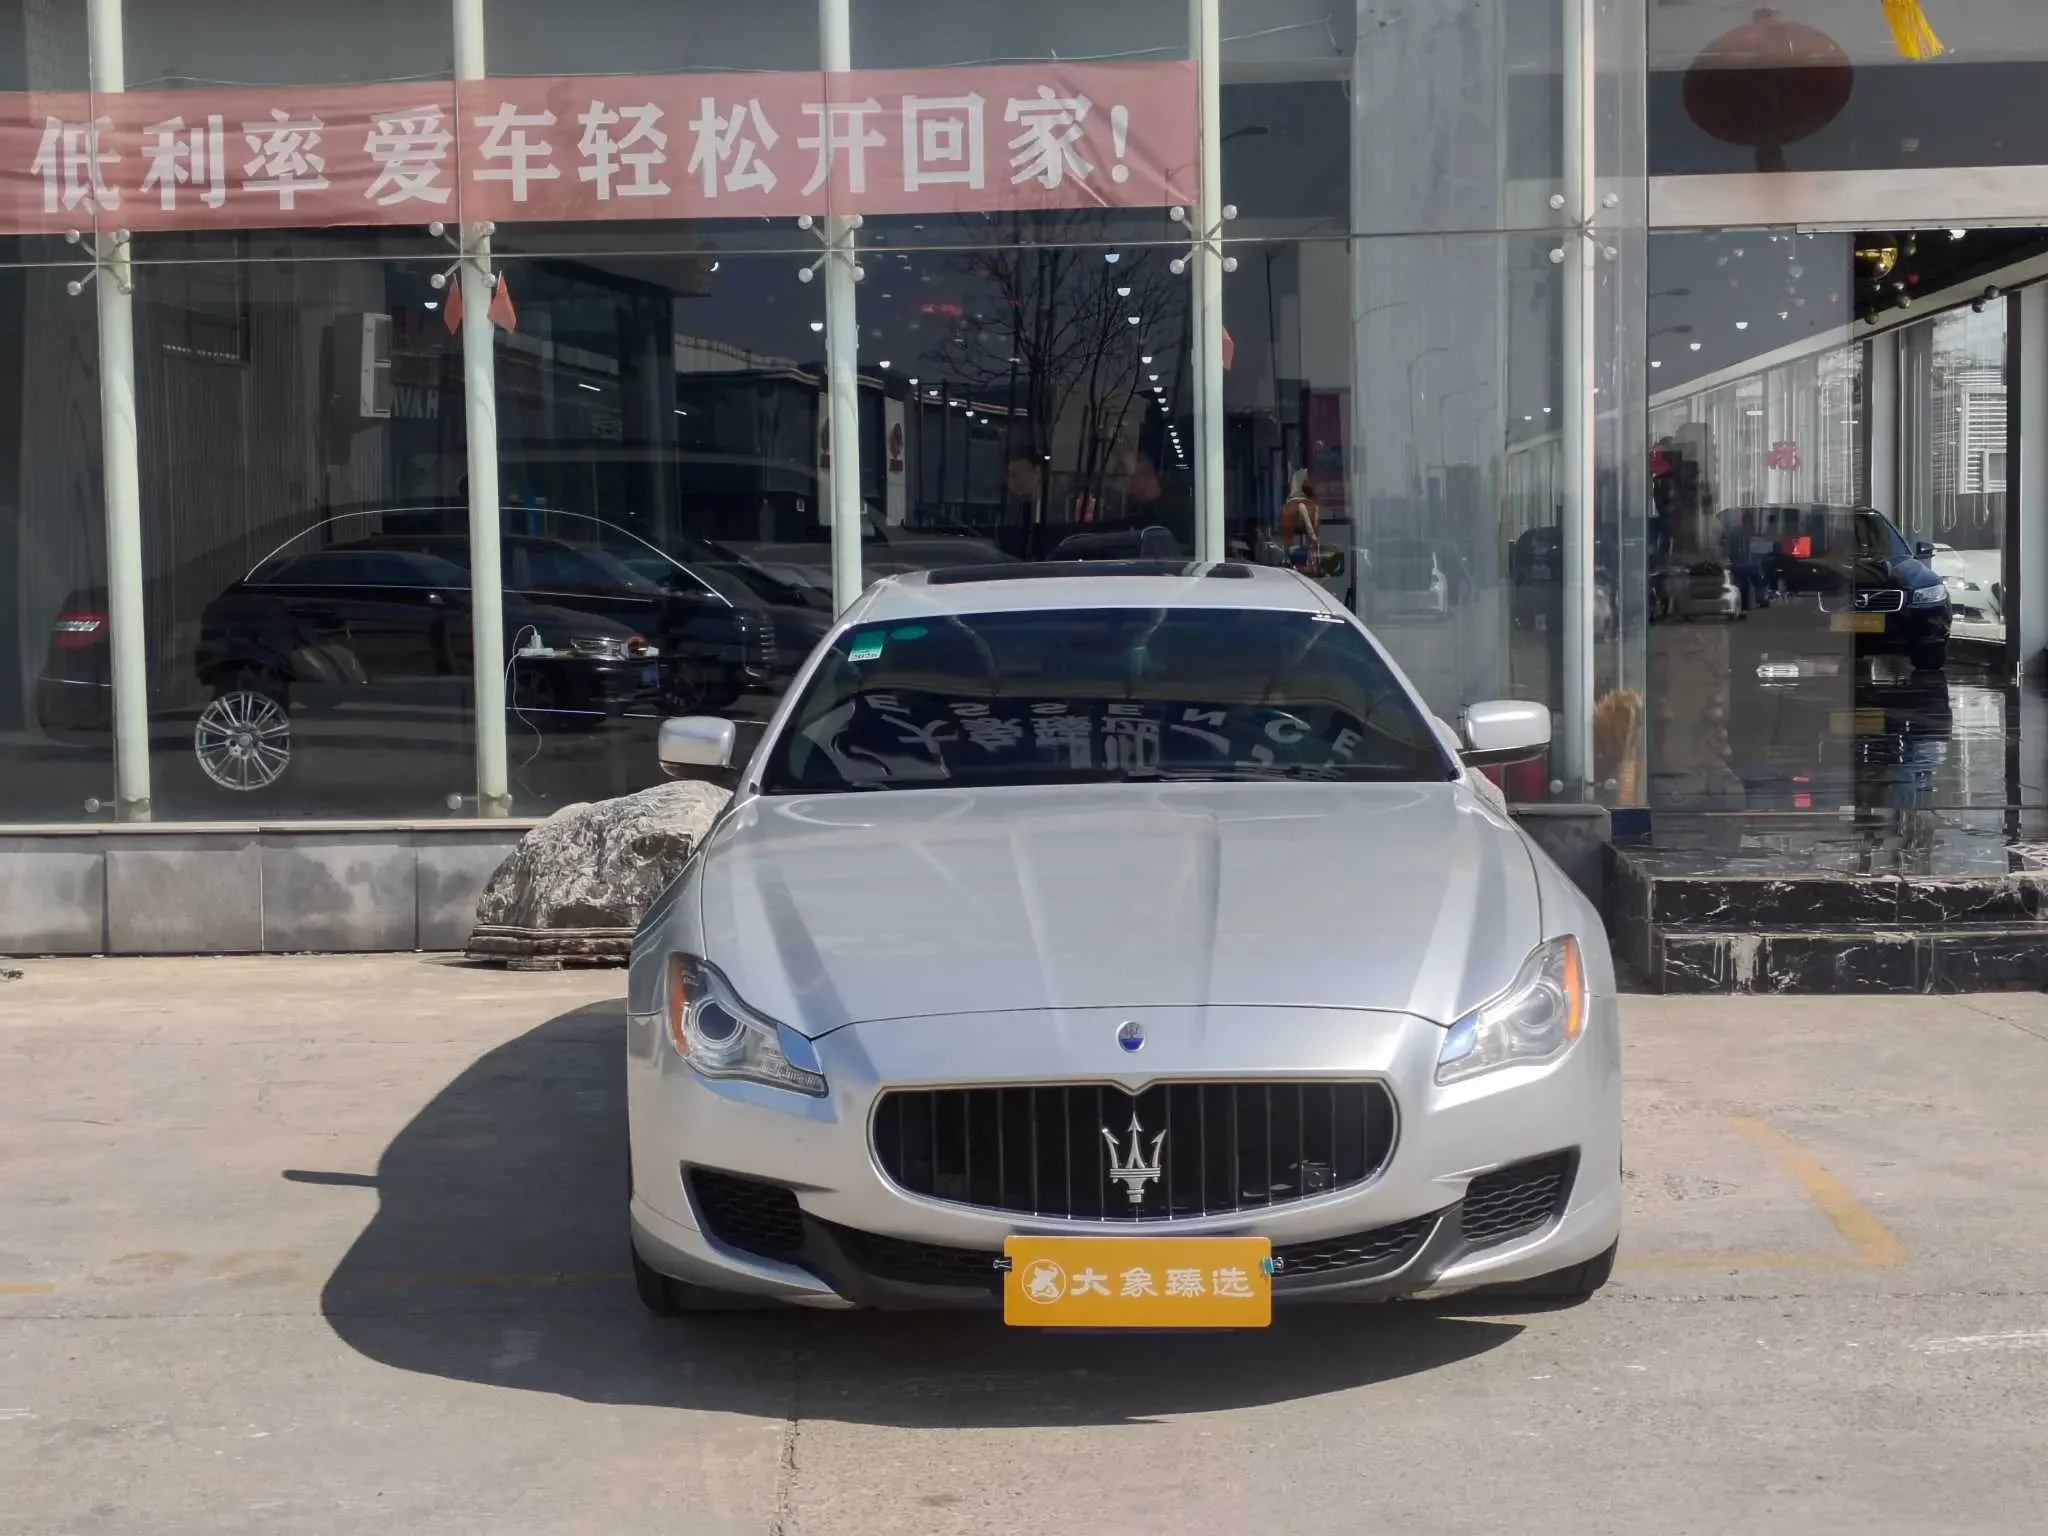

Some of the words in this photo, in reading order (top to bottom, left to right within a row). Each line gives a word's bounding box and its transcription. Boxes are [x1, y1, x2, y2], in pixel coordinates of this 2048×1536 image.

[31, 108, 331, 213] 低利率
[1070, 1266, 1255, 1299] 大象臻选
